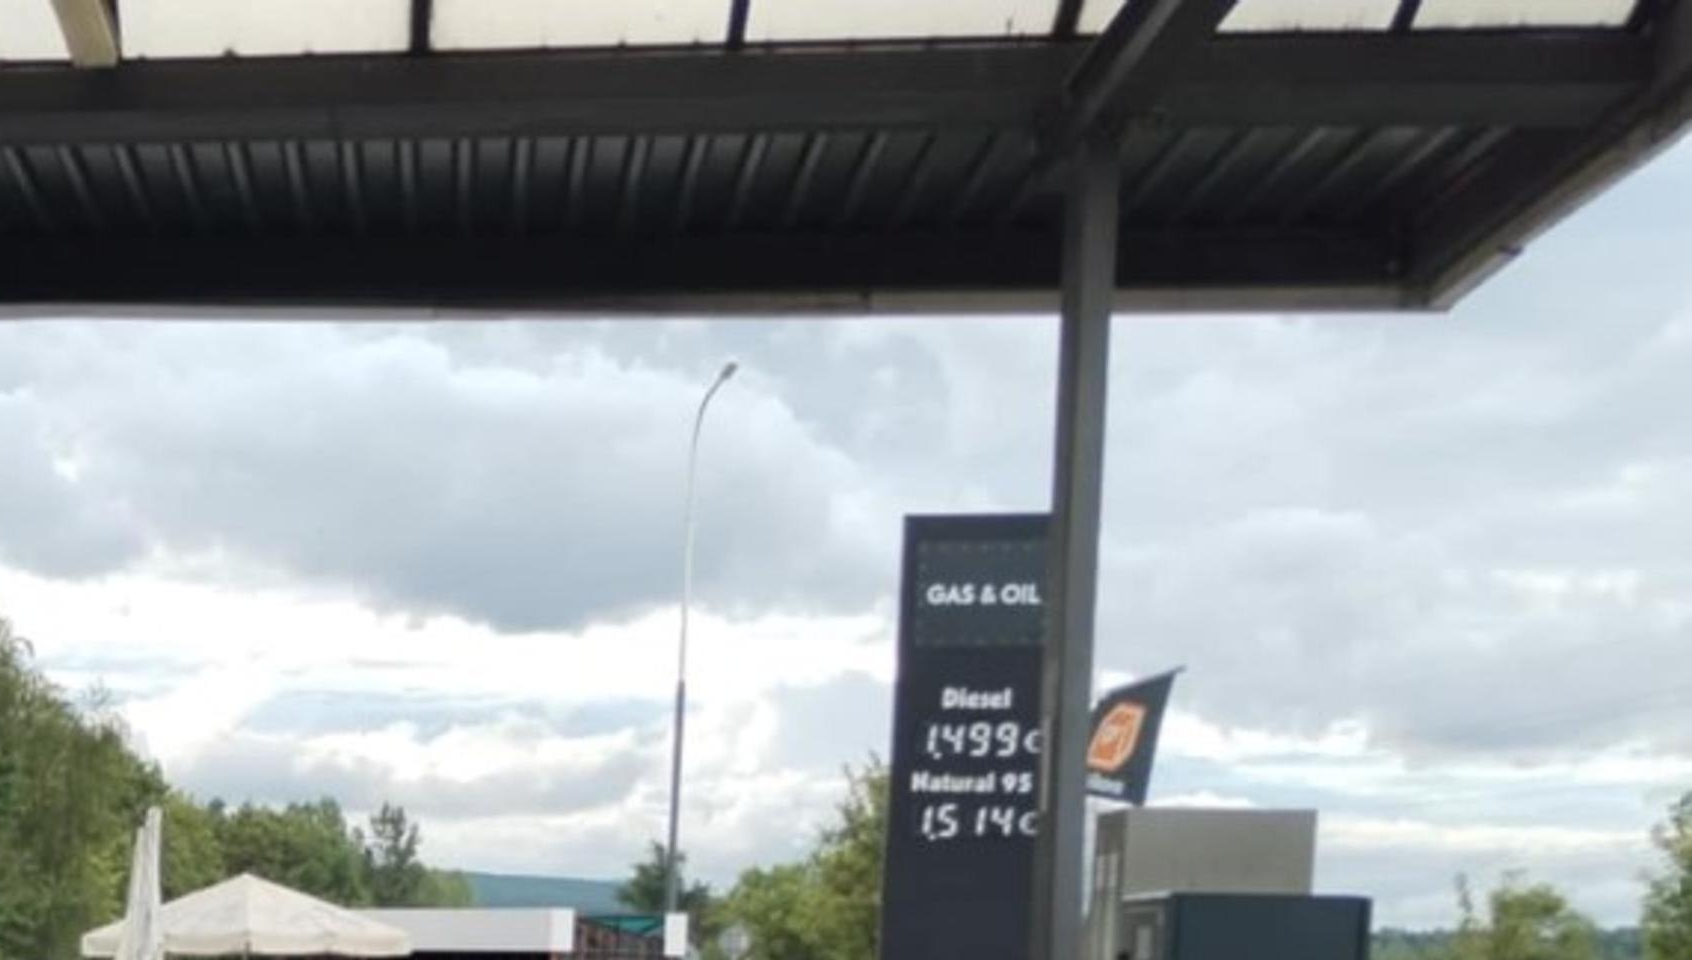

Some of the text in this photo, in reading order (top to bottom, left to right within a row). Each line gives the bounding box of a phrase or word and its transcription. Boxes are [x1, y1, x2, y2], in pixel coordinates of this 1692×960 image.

[926, 583, 1042, 606] GAS & OIL
[941, 686, 1012, 710] Diesel
[910, 770, 1033, 793] Natural 95
